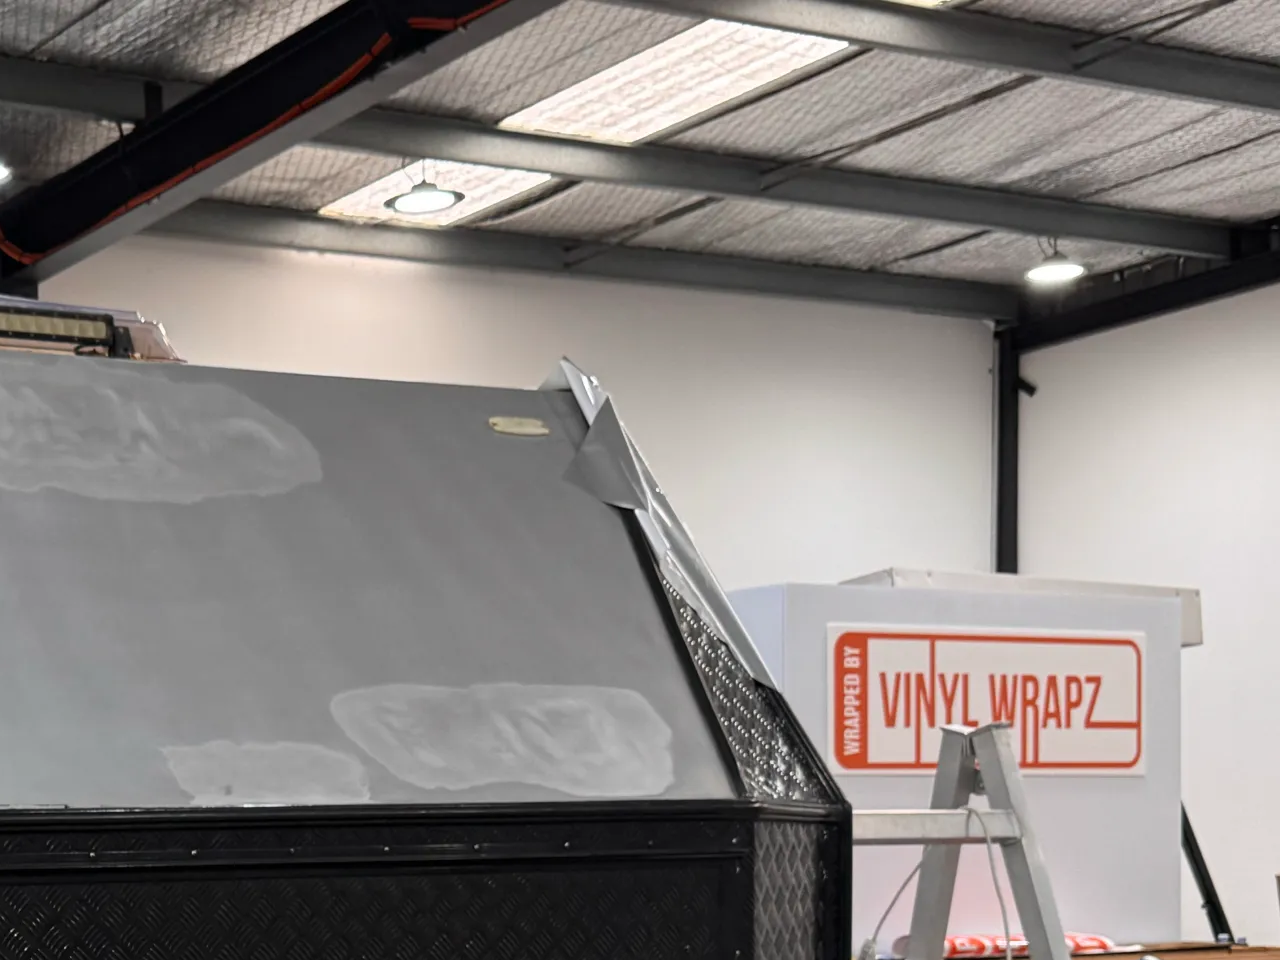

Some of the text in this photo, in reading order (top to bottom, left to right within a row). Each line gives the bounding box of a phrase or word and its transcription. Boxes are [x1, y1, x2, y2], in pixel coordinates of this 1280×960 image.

[843, 645, 862, 756] WRAPPED BY
[878, 670, 1103, 730] VINYL WRAPZ
